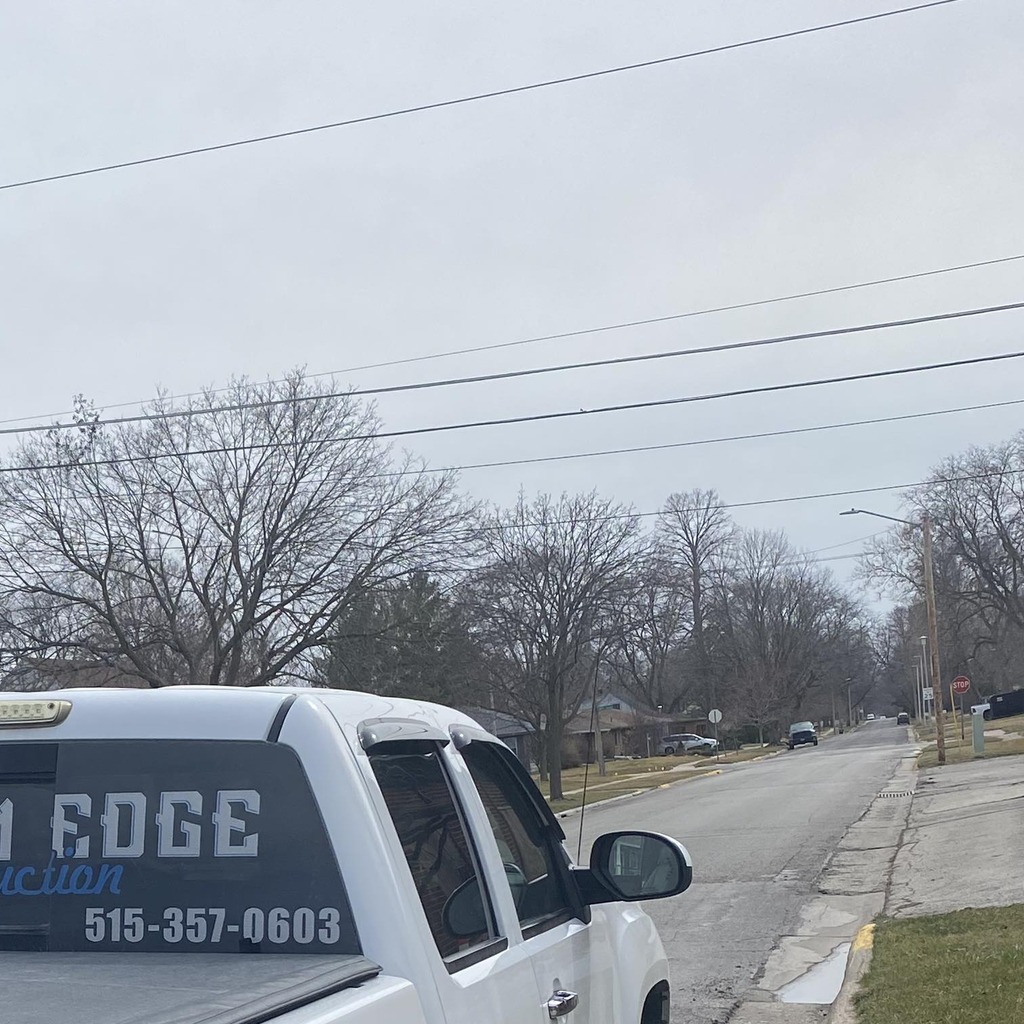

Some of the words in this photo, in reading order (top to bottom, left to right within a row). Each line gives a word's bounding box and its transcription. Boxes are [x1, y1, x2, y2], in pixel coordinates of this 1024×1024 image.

[953, 681, 969, 689] STOP
[50, 789, 262, 860] EDGE
[84, 906, 341, 945] 515-357-0603
